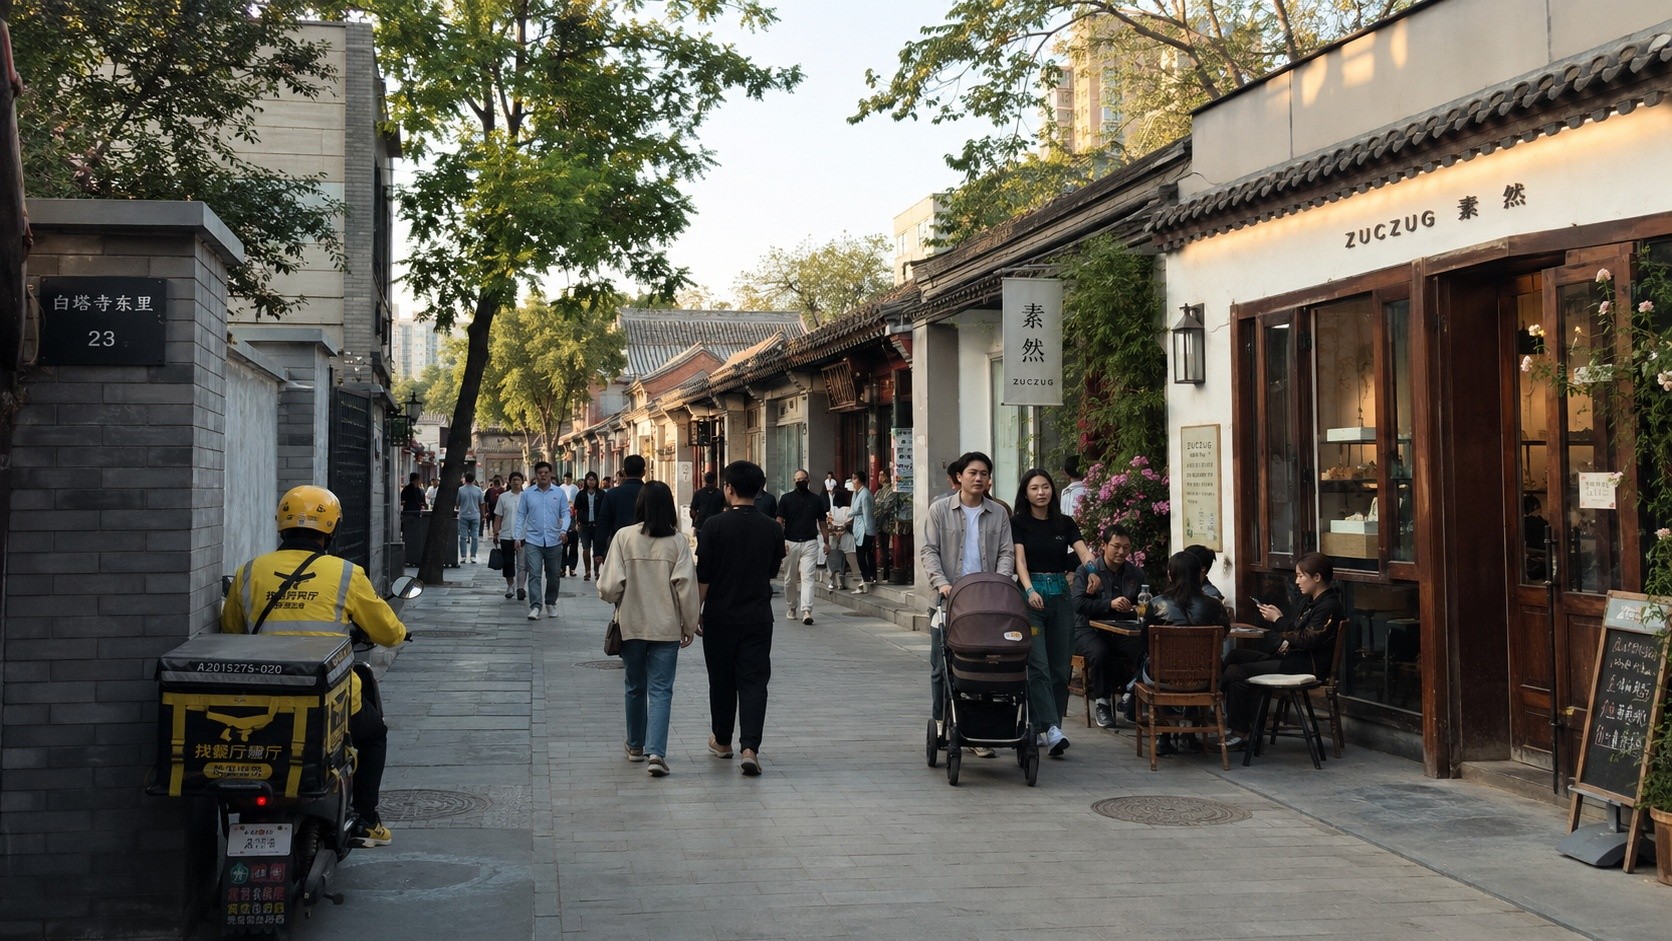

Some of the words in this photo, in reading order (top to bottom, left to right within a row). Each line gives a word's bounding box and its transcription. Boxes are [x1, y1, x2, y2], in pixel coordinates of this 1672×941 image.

[1344, 210, 1436, 249] ZUCZUG
[1457, 182, 1526, 222] 素然
[53, 294, 154, 312] 白塔寺东里
[88, 330, 115, 347] 23
[1021, 303, 1045, 363] 素然
[1013, 378, 1054, 386] ZUCZUG
